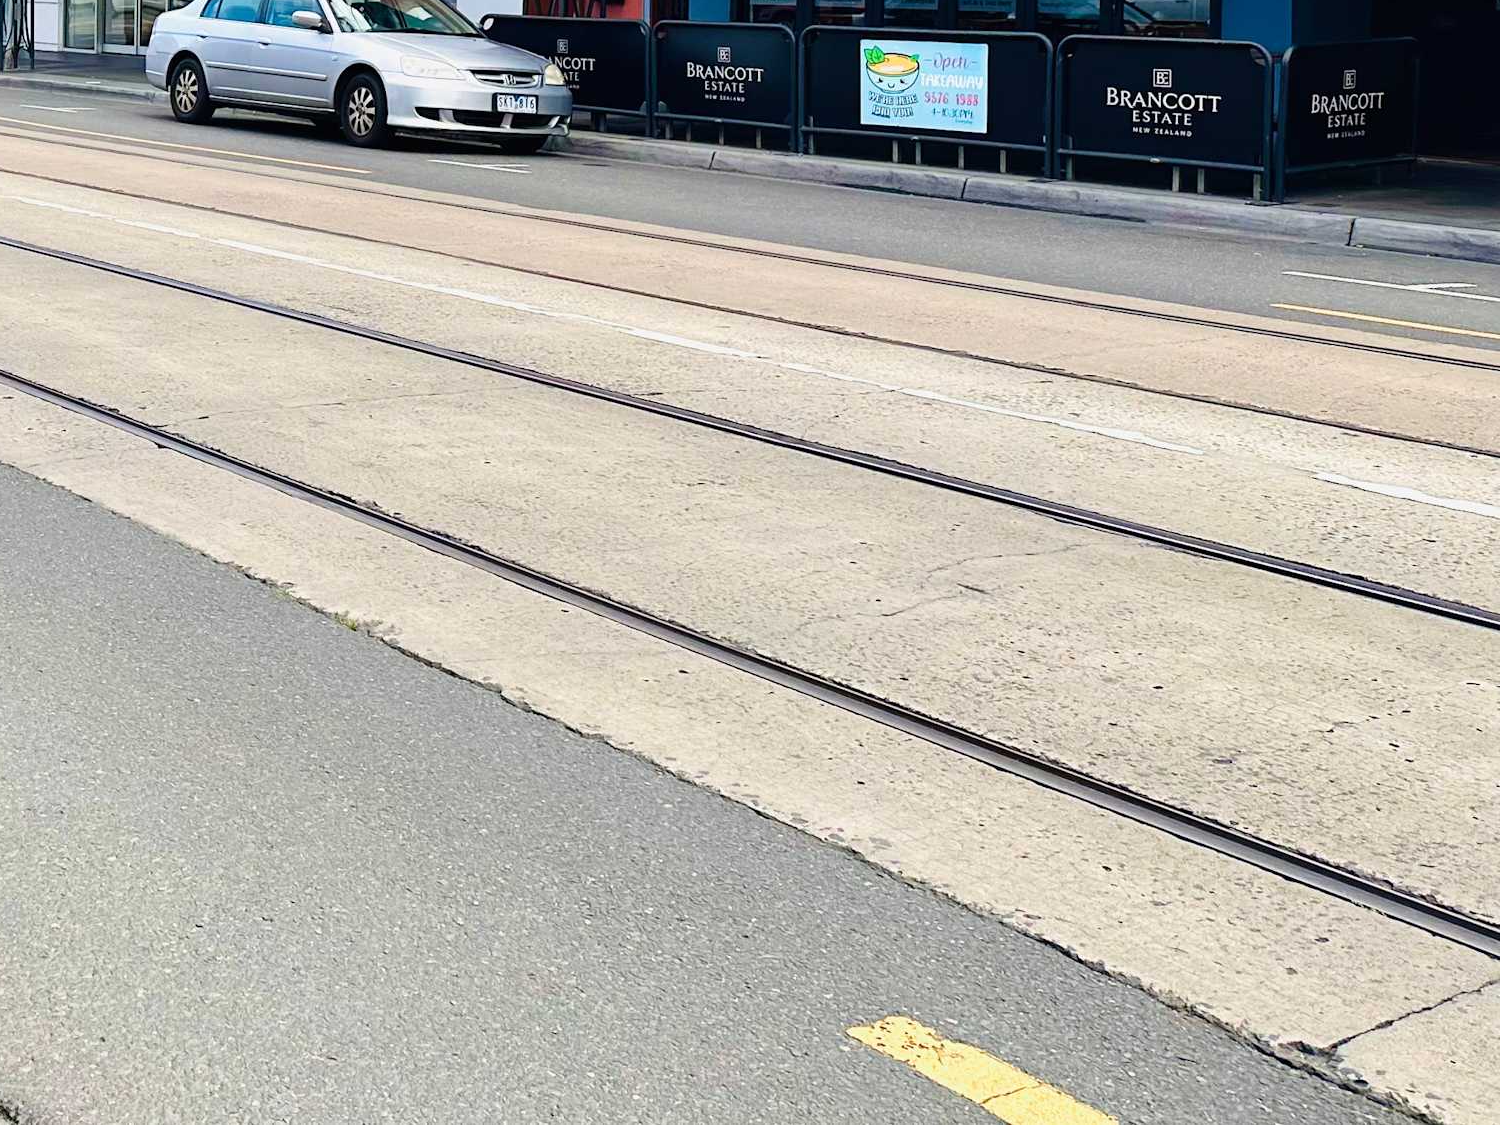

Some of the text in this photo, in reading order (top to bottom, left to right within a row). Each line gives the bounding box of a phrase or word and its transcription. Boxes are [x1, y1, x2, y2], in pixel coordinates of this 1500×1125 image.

[686, 62, 764, 82] BRANCOTT
[705, 81, 745, 93] ESTATE
[921, 73, 984, 90] TAKEAWAY
[924, 91, 979, 106] 9576 1988
[1106, 87, 1221, 112] BRANCOTT
[1311, 92, 1384, 114] BRANCOTT
[1132, 110, 1192, 126] ESTATE
[1328, 113, 1366, 128] ESTATE
[1155, 128, 1192, 137] ZEALAND
